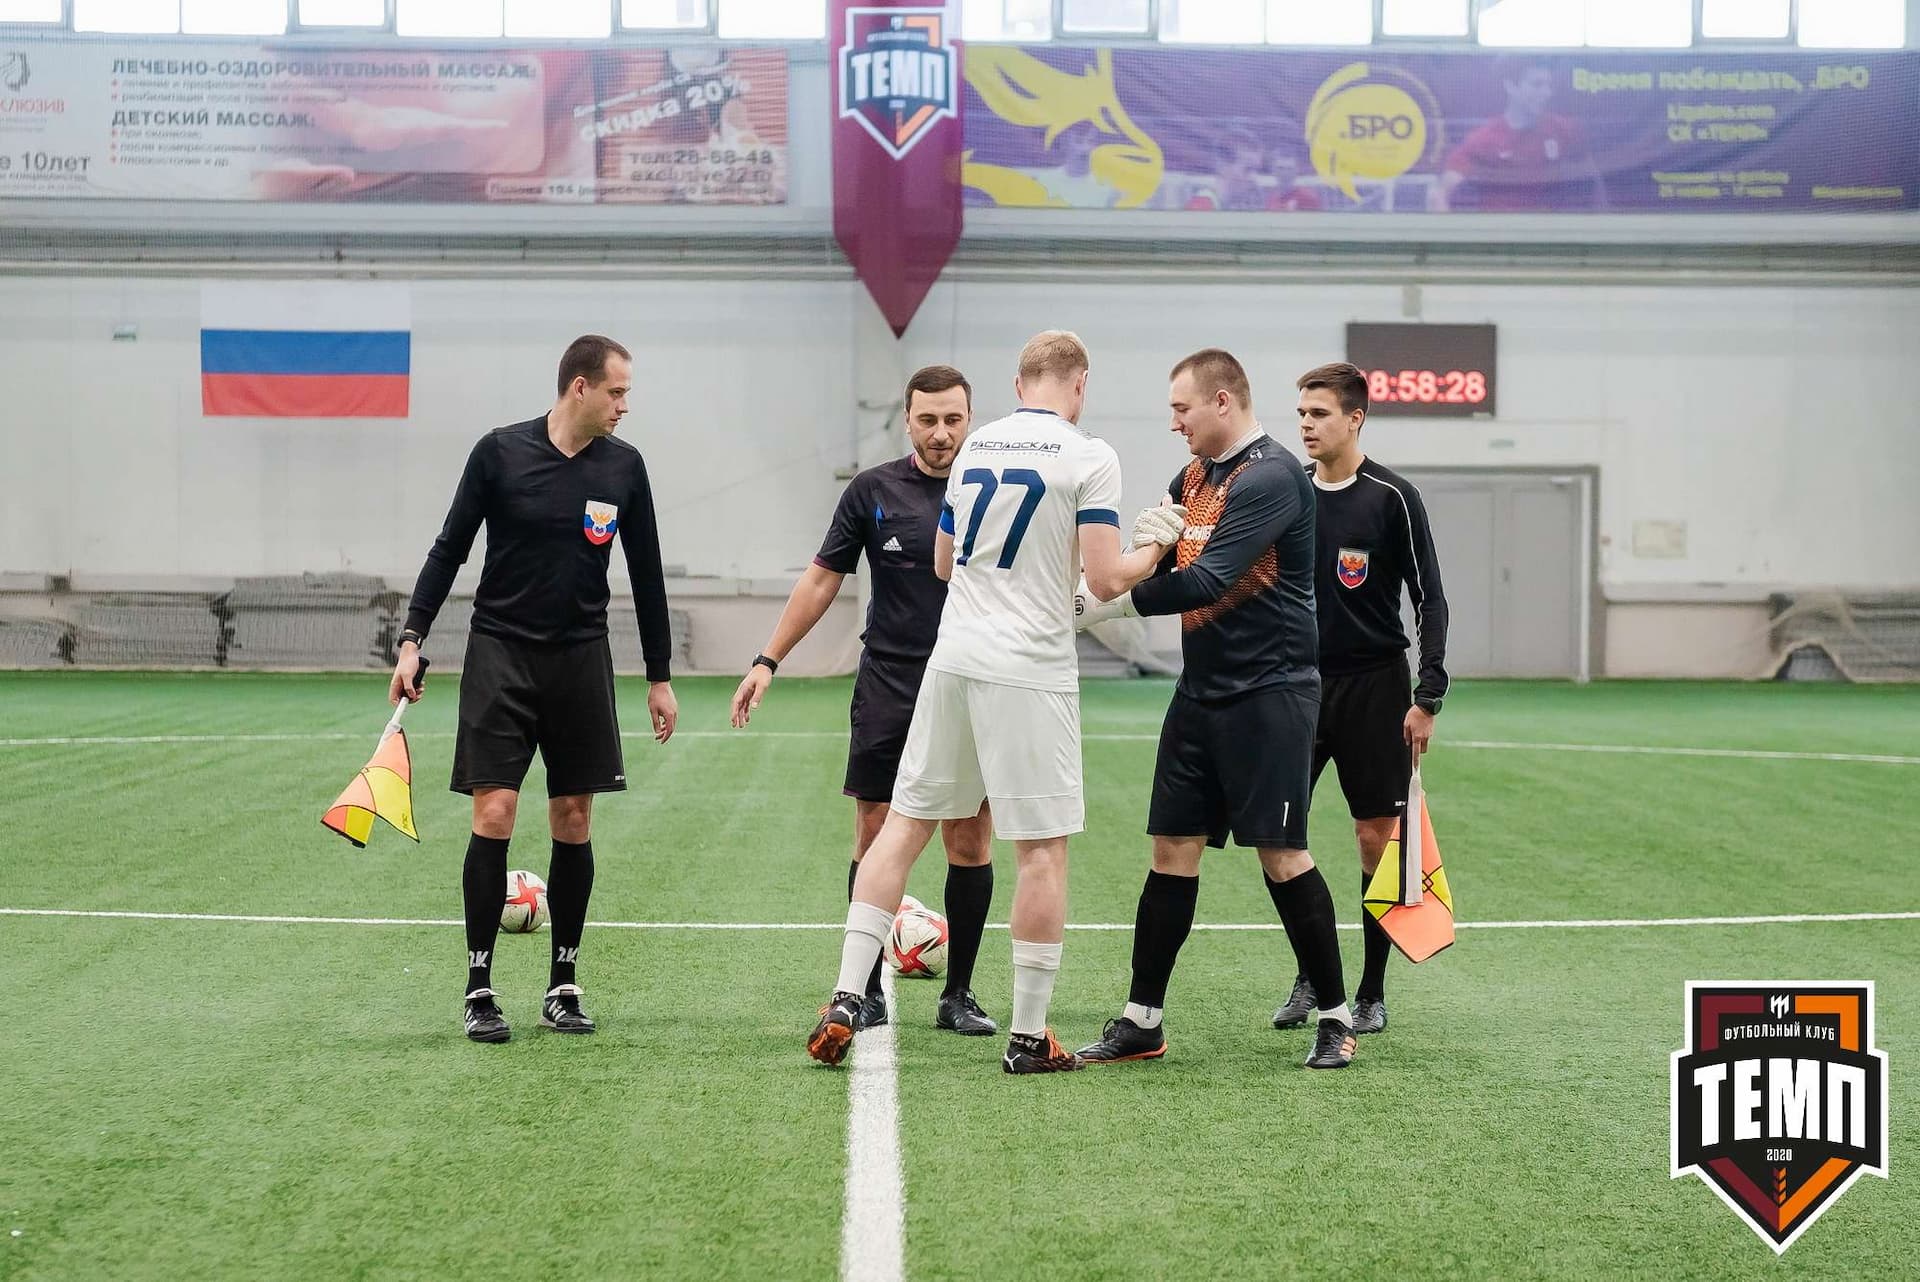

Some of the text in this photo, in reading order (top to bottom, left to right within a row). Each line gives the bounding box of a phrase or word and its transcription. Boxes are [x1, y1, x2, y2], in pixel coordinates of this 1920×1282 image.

[112, 59, 536, 79] ЛЕЧЕБНО-ОЗДОРОВИТЕЛЬНЫЙ МАССАЖ:
[851, 50, 946, 101] ТЕМП
[686, 73, 751, 108] 20%
[112, 108, 315, 128] ДЕТСКИЙ МАССАЖ:
[1338, 114, 1413, 140] .БРО
[1361, 369, 1487, 403] 8:58:28
[957, 467, 1046, 570] 77
[1282, 801, 1290, 828] 1
